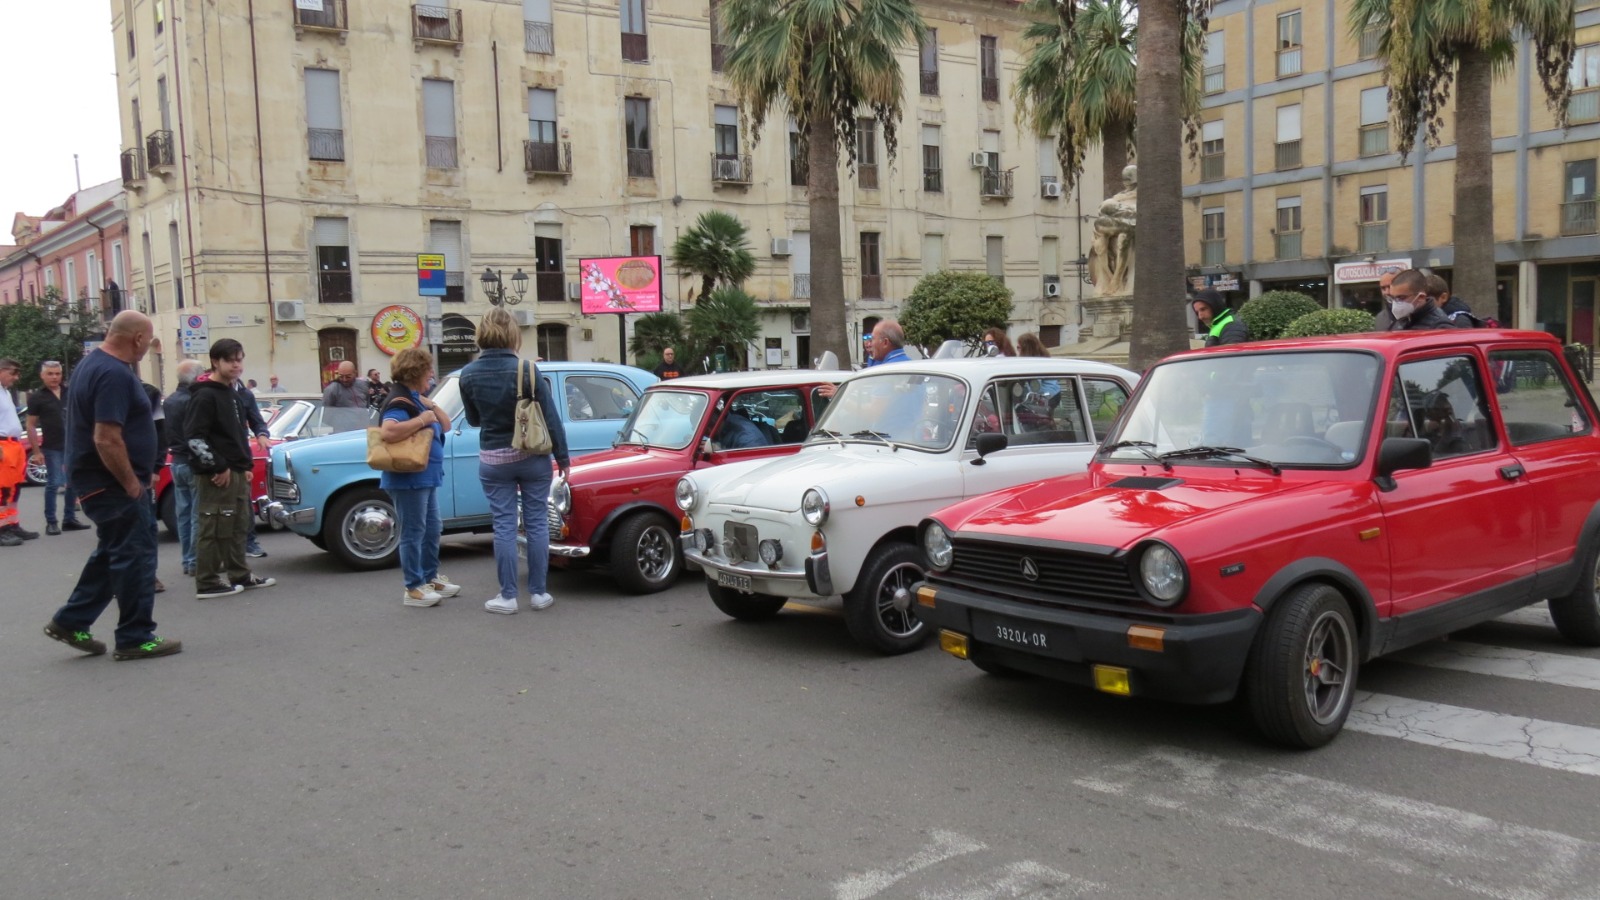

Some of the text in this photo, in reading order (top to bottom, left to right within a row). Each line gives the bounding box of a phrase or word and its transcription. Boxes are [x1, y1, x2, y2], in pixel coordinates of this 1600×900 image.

[1340, 266, 1375, 279] AUTOSCUOLA
[996, 625, 1047, 647] 39204 OR
